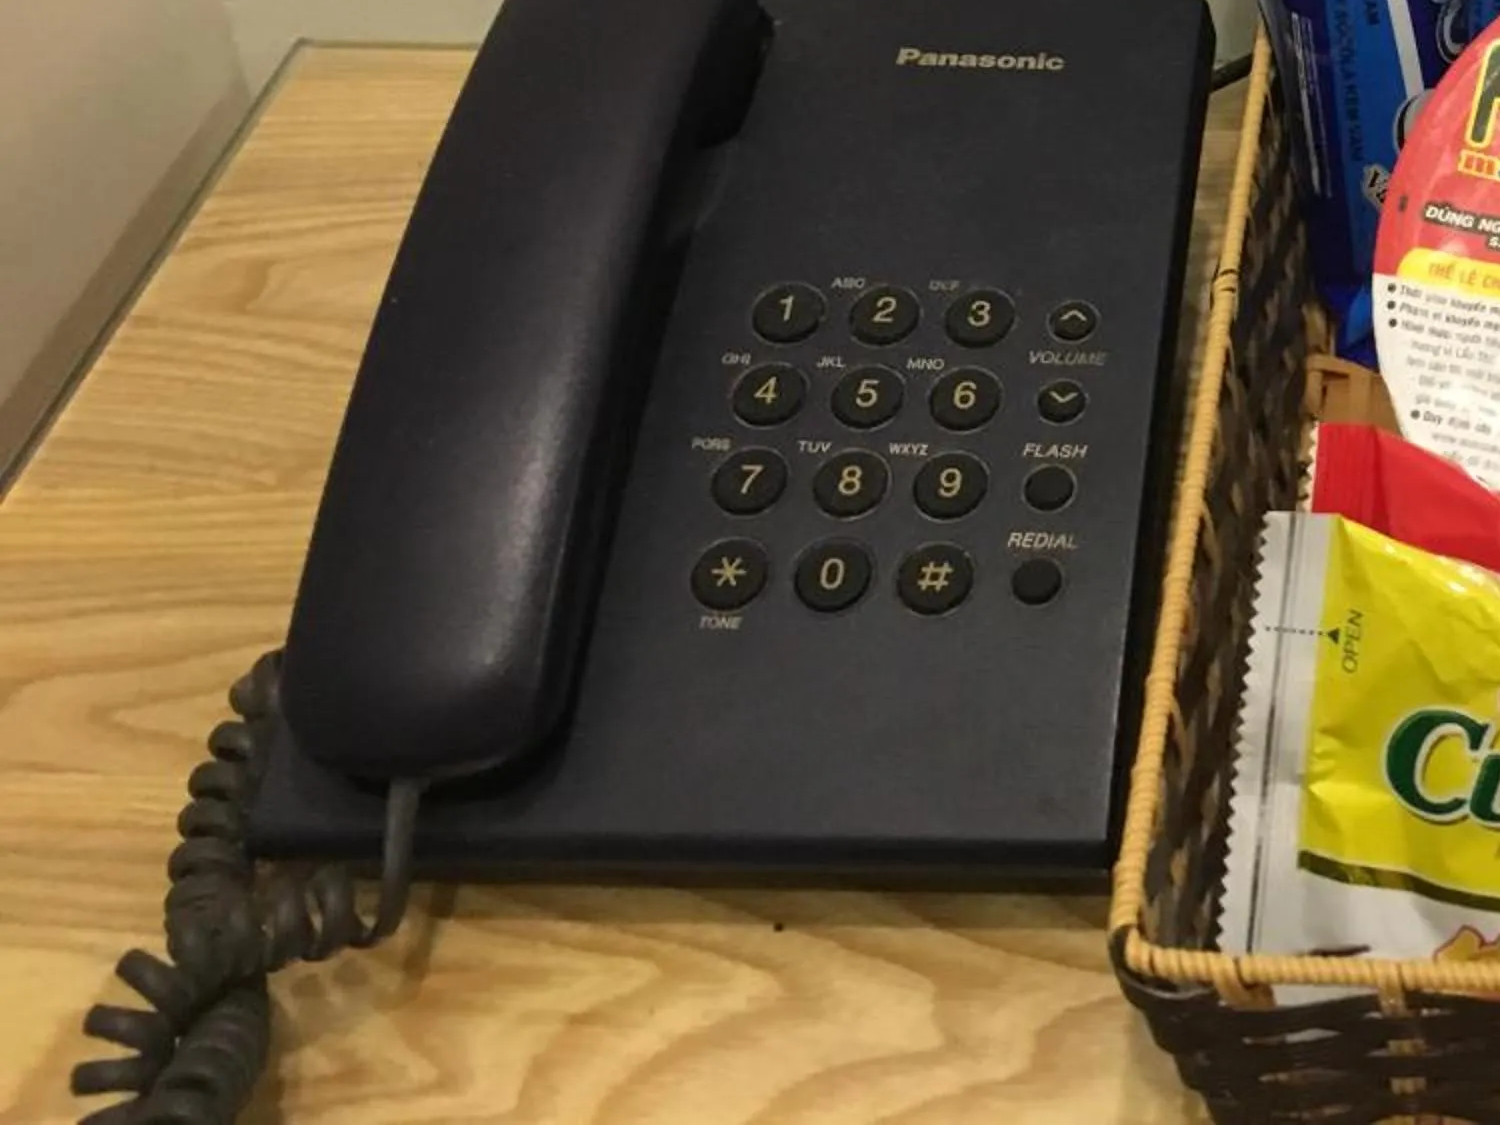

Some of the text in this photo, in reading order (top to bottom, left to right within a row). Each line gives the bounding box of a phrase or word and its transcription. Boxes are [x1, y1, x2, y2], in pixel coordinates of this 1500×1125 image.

[896, 47, 1066, 72] Panasonic
[779, 295, 795, 321] 1
[872, 296, 897, 323] 2
[966, 300, 992, 327] 3
[906, 357, 945, 370] MNO
[1028, 350, 1110, 367] VOLUME
[754, 376, 778, 404] 4
[855, 379, 880, 408] 5
[952, 381, 978, 410] 6
[797, 440, 832, 454] TUV
[888, 442, 929, 456] WXYZ
[1022, 443, 1088, 460] FLASH
[739, 465, 763, 493] 7
[838, 467, 862, 496] 8
[937, 468, 962, 498] 9
[1007, 532, 1081, 550] REDIAL
[820, 558, 845, 589] 0
[917, 561, 954, 591] #
[699, 615, 742, 630] TONE
[1340, 608, 1364, 674] OPEN
